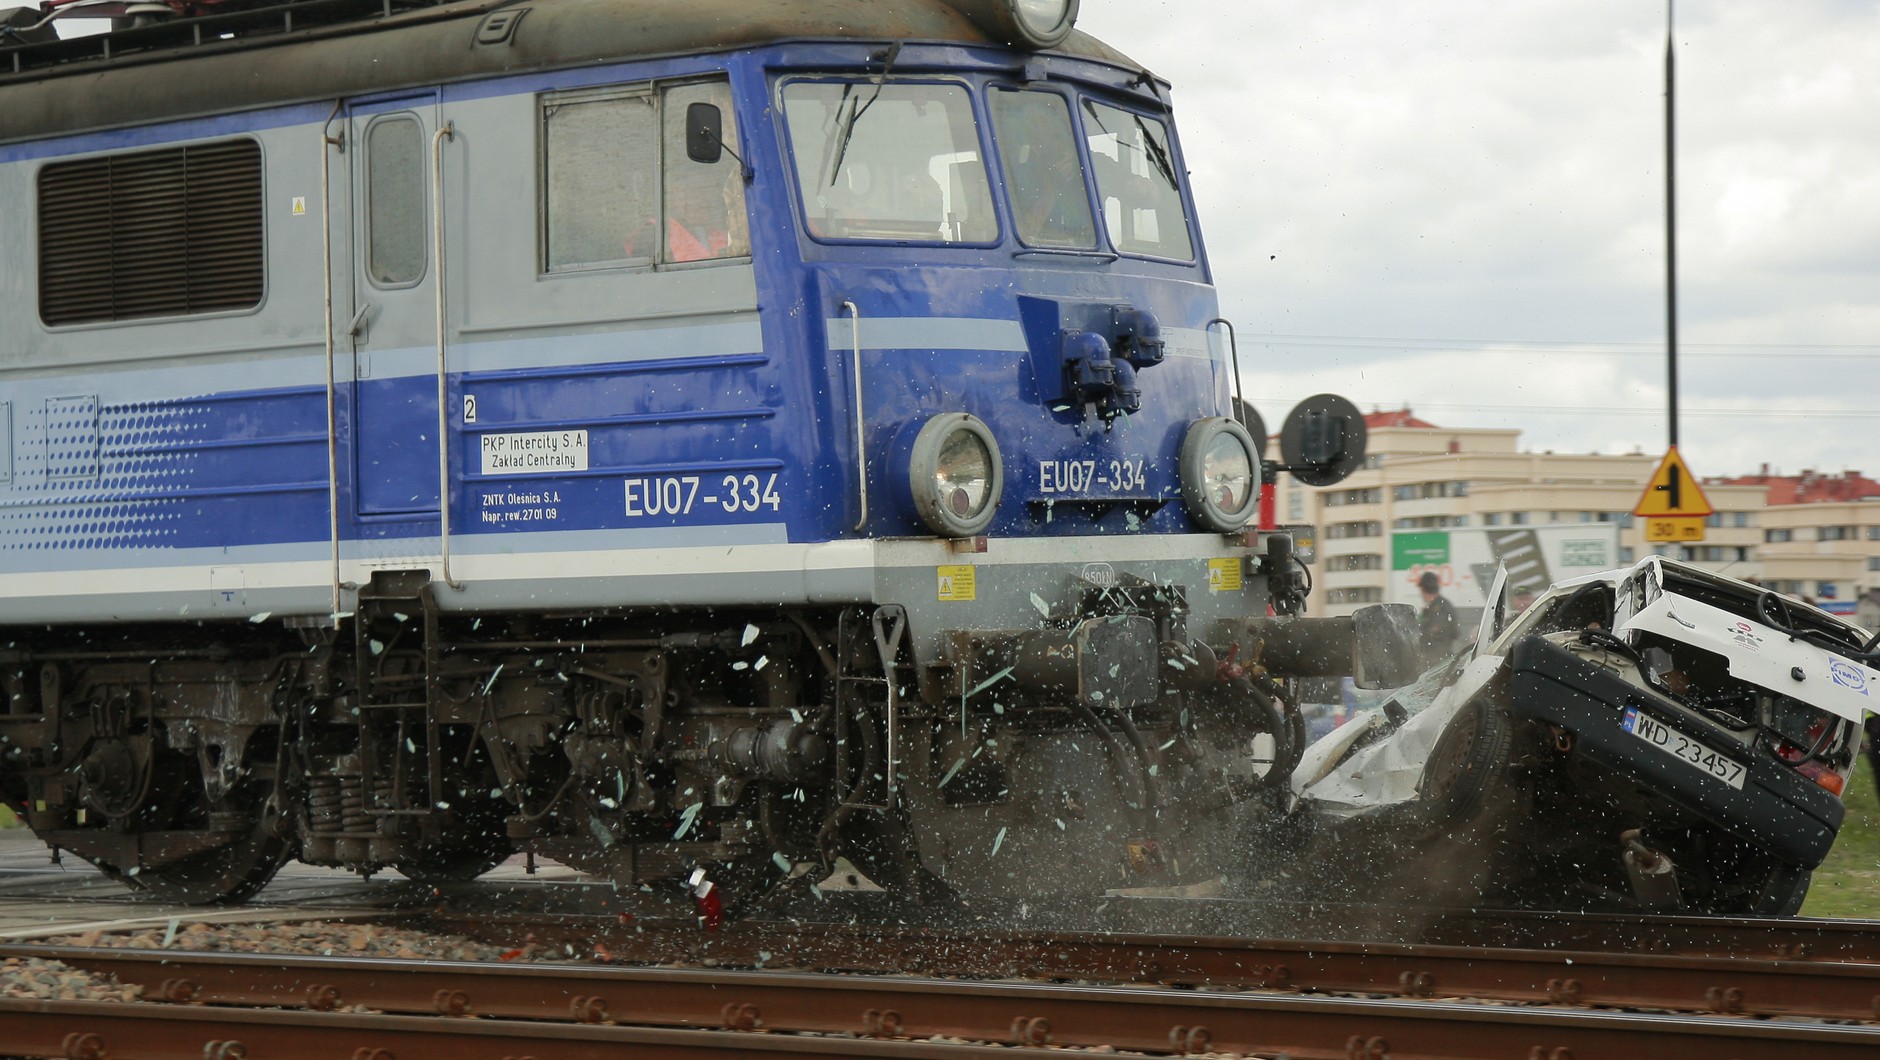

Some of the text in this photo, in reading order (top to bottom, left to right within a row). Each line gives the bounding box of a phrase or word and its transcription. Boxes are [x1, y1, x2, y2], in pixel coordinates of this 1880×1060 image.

[465, 398, 475, 419] 2
[483, 437, 505, 452] PKP
[510, 434, 558, 452] Intercity
[492, 452, 576, 468] Zakład Centralny
[1040, 459, 1146, 493] EU07-334
[482, 493, 505, 506] ZNTK
[624, 473, 781, 517] EU07-334
[482, 510, 504, 525] Napr.
[545, 507, 557, 519] 09
[1654, 523, 1698, 536] 30 m
[1637, 715, 1743, 782] WD 23457
